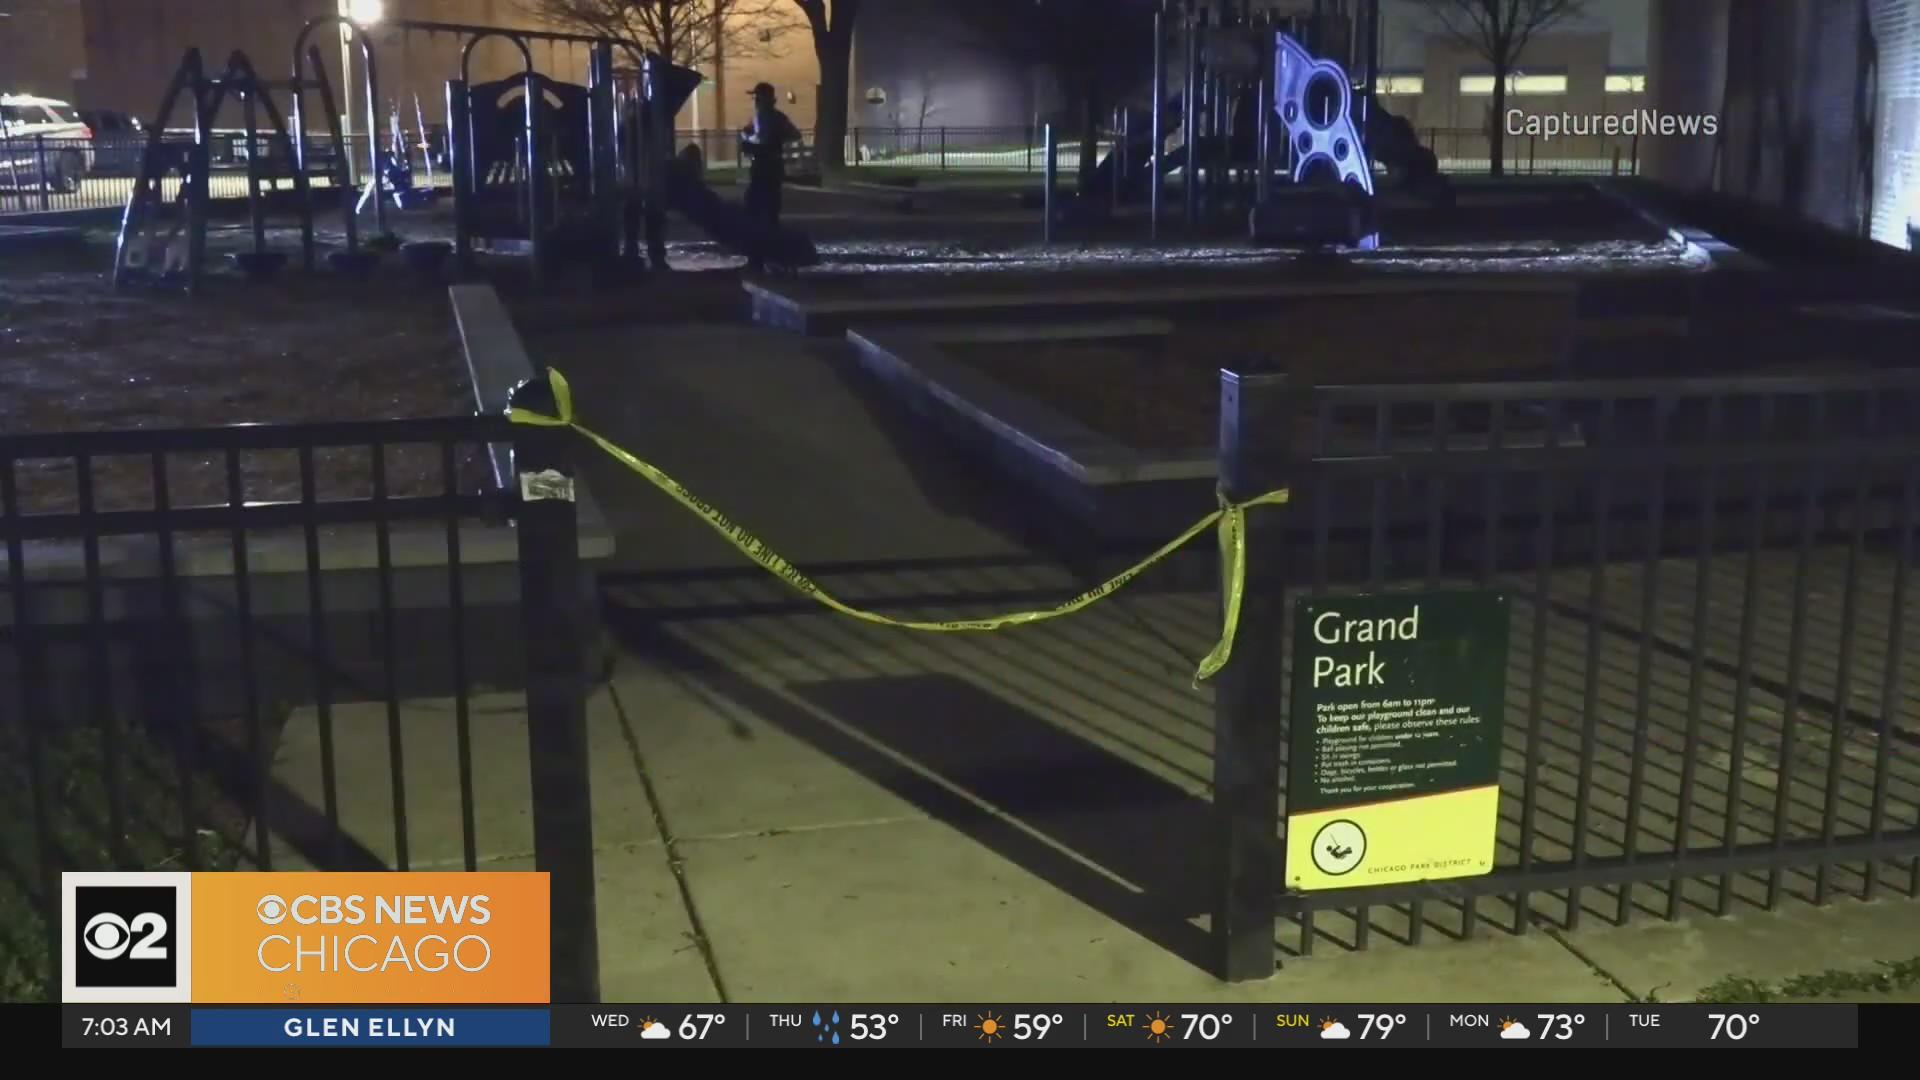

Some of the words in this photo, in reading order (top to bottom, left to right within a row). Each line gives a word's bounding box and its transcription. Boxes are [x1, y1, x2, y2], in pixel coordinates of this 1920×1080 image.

[1313, 604, 1420, 645] Grand
[1313, 650, 1387, 689] Park
[1316, 702, 1336, 712] Park
[1337, 703, 1359, 713] open
[1360, 699, 1381, 709] from
[1382, 699, 1402, 708] 6am
[1403, 699, 1412, 707] to
[1317, 713, 1328, 723] To
[1329, 713, 1350, 725] keep
[1351, 713, 1366, 721] our
[1367, 710, 1414, 722] playground
[1415, 708, 1437, 717] clean
[1439, 704, 1455, 716] and
[1455, 705, 1471, 714] our
[1316, 724, 1351, 735] children
[1374, 719, 1401, 733] please
[1401, 719, 1435, 729] observe
[1435, 717, 1458, 727] these
[1367, 864, 1408, 874] CHICAGO
[1410, 862, 1431, 870] PARK
[1433, 858, 1472, 869] DISTRICT
